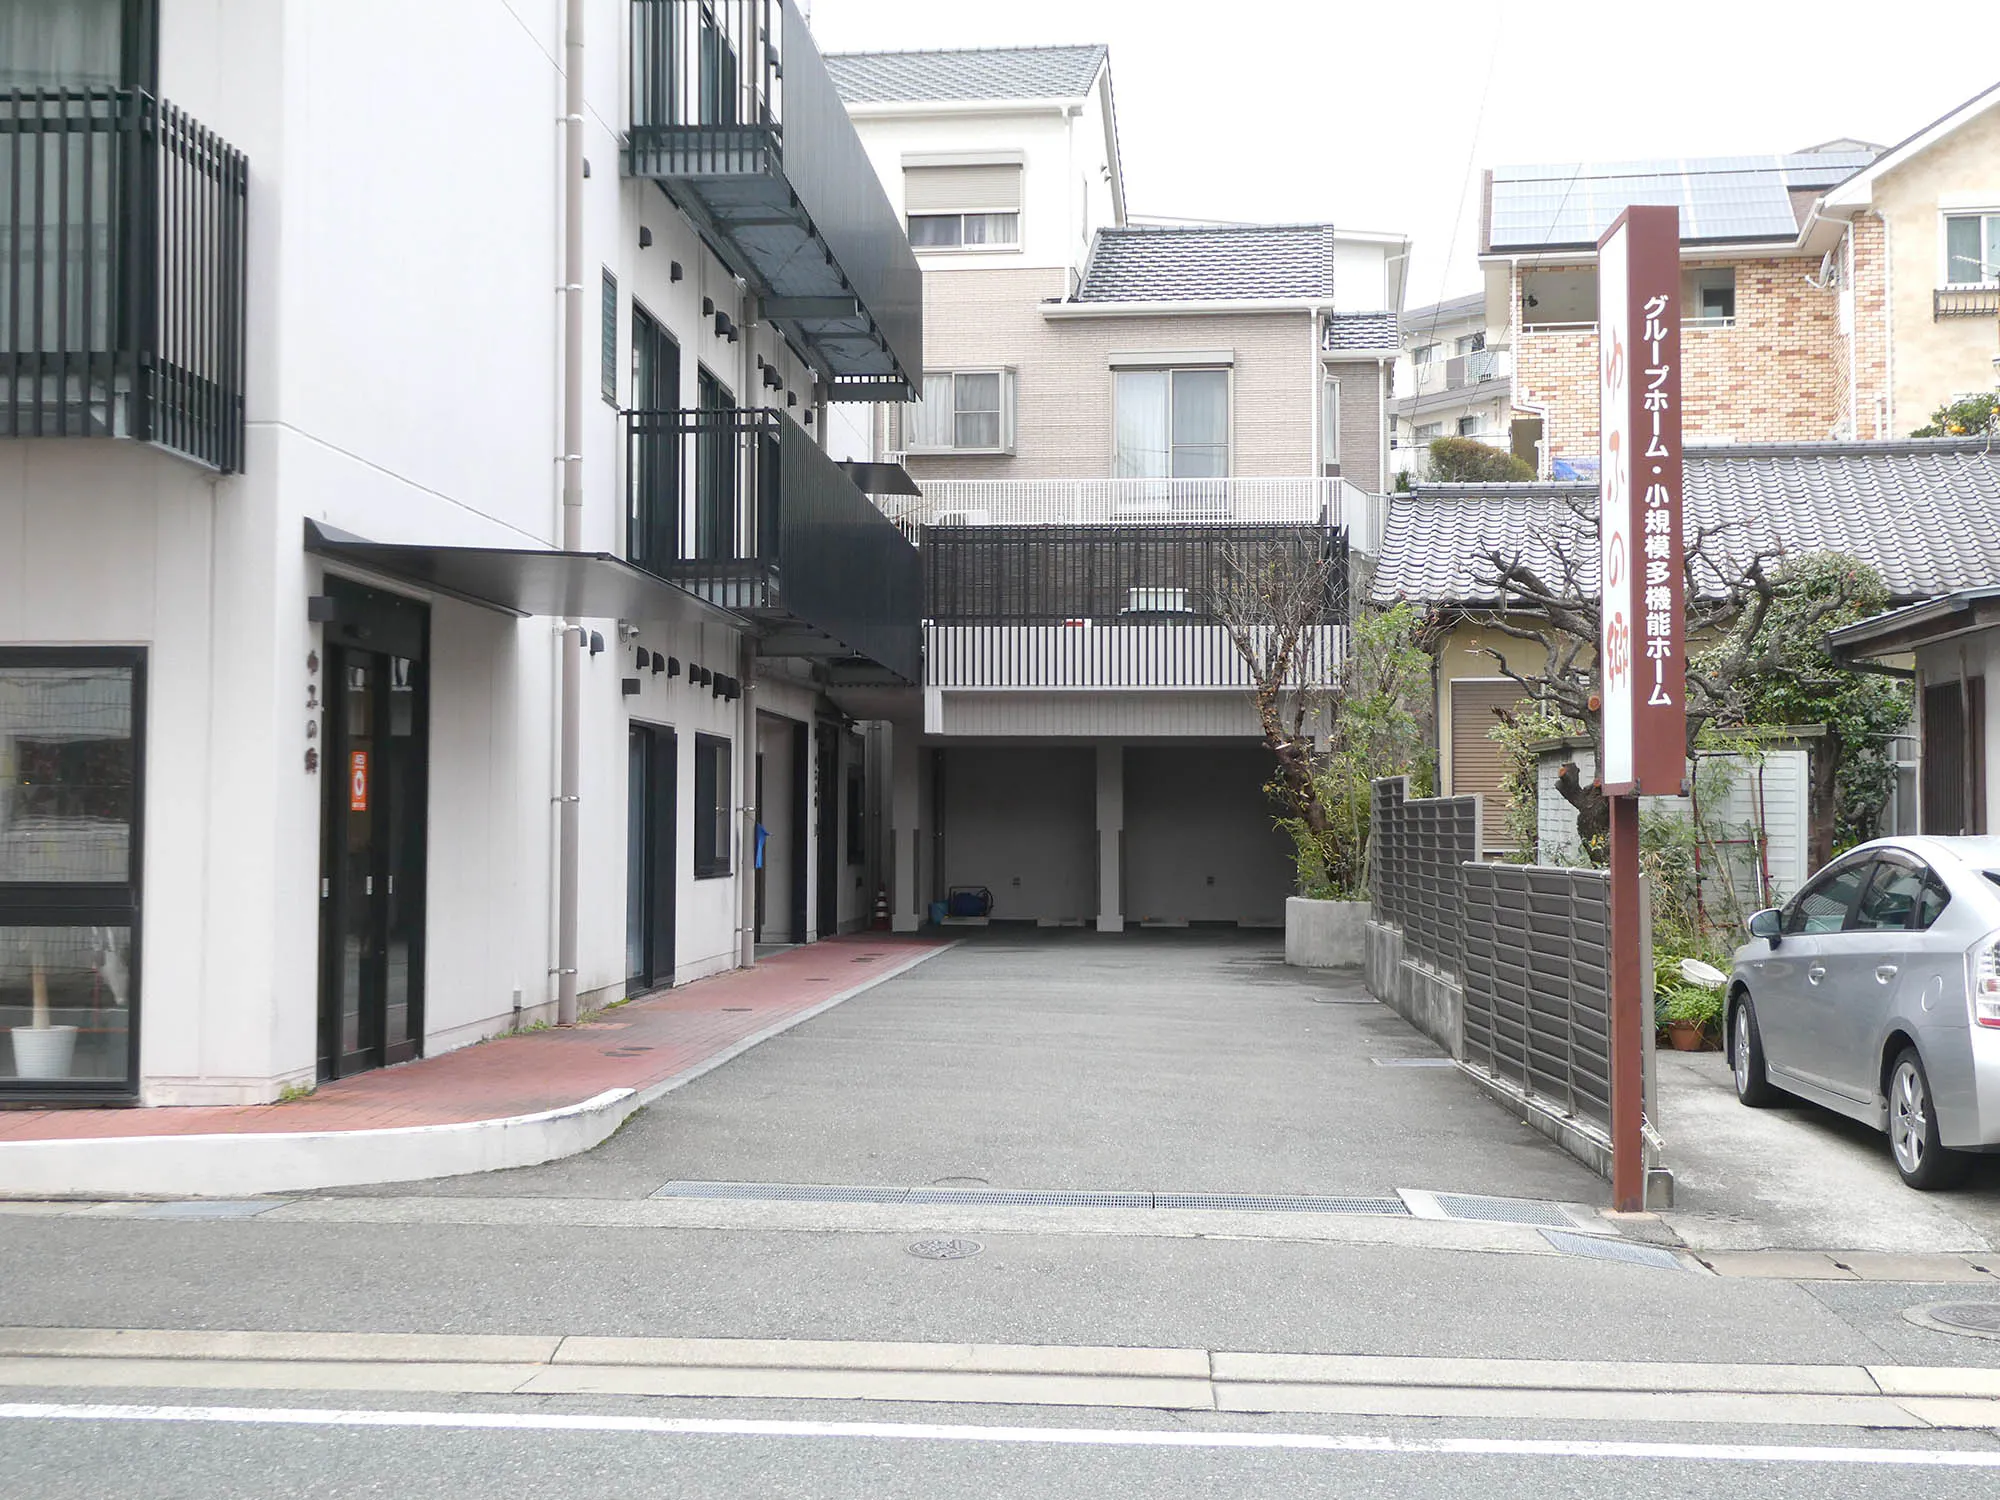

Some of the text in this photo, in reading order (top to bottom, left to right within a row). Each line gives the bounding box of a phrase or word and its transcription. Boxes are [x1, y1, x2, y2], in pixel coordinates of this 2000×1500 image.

[1605, 324, 1629, 693] ゆふの郷
[1643, 294, 1672, 706] グループホーム・小規模多機能ホーム
